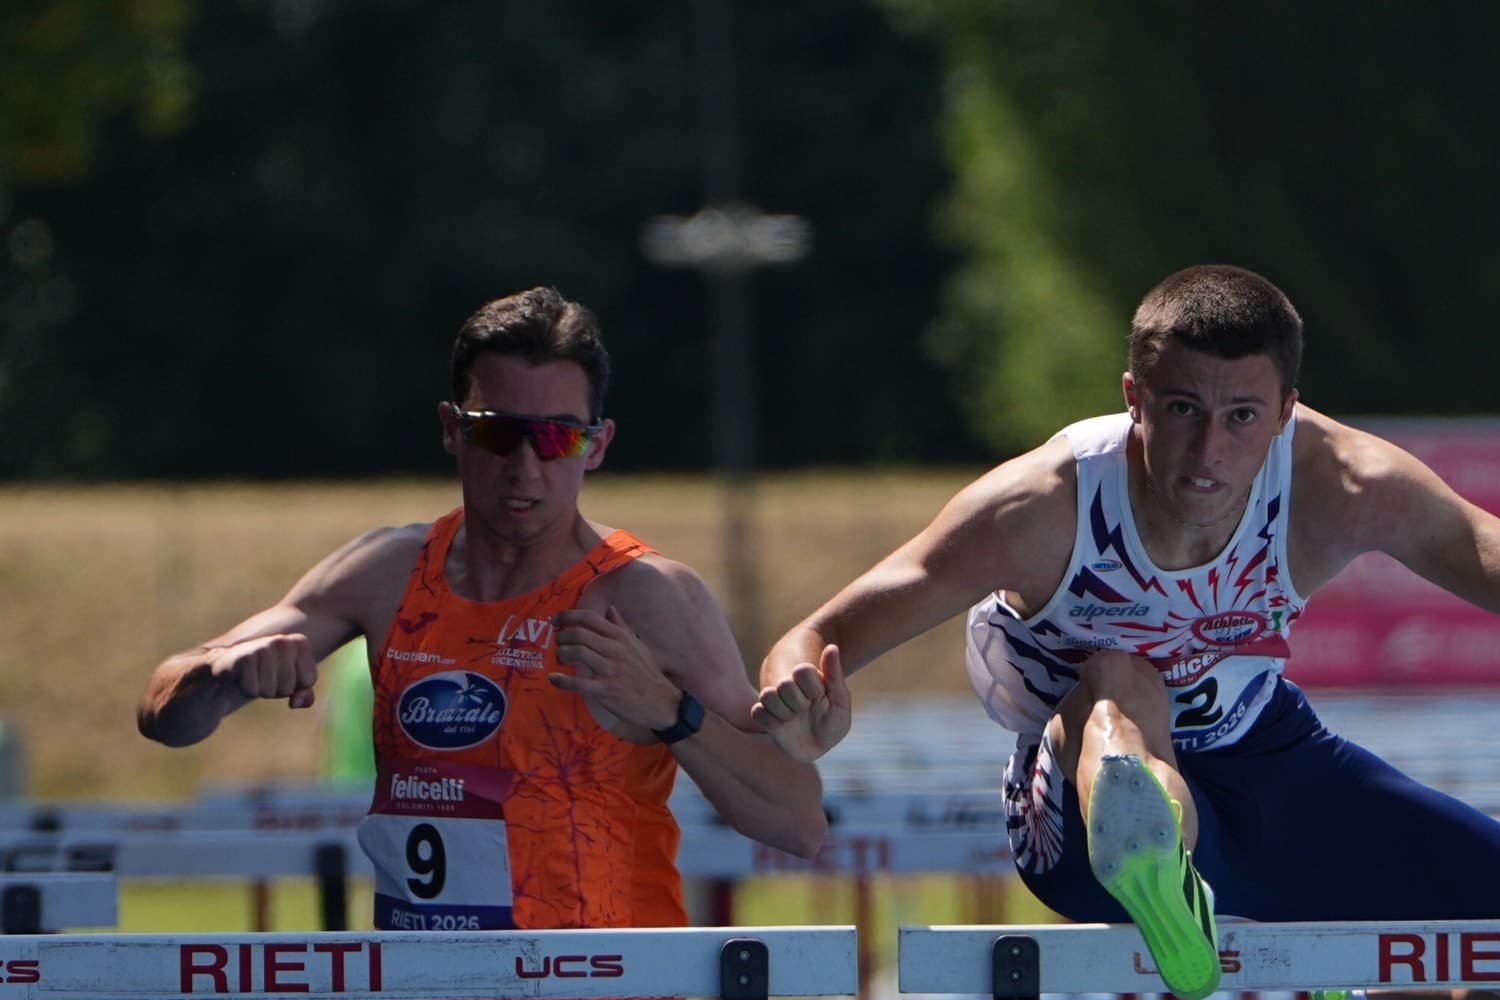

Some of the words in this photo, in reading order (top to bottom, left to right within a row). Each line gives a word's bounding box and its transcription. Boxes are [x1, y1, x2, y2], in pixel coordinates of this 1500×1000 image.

[1068, 603, 1150, 621] alperia
[1175, 676, 1223, 728] 2
[1204, 702, 1246, 744] 2026
[391, 773, 465, 801] felicetti
[406, 823, 446, 899] 9
[391, 908, 426, 930] RIETI
[431, 915, 480, 930] 2026
[180, 943, 382, 993] RIETI
[516, 954, 624, 979] UCS
[1134, 949, 1242, 975] US
